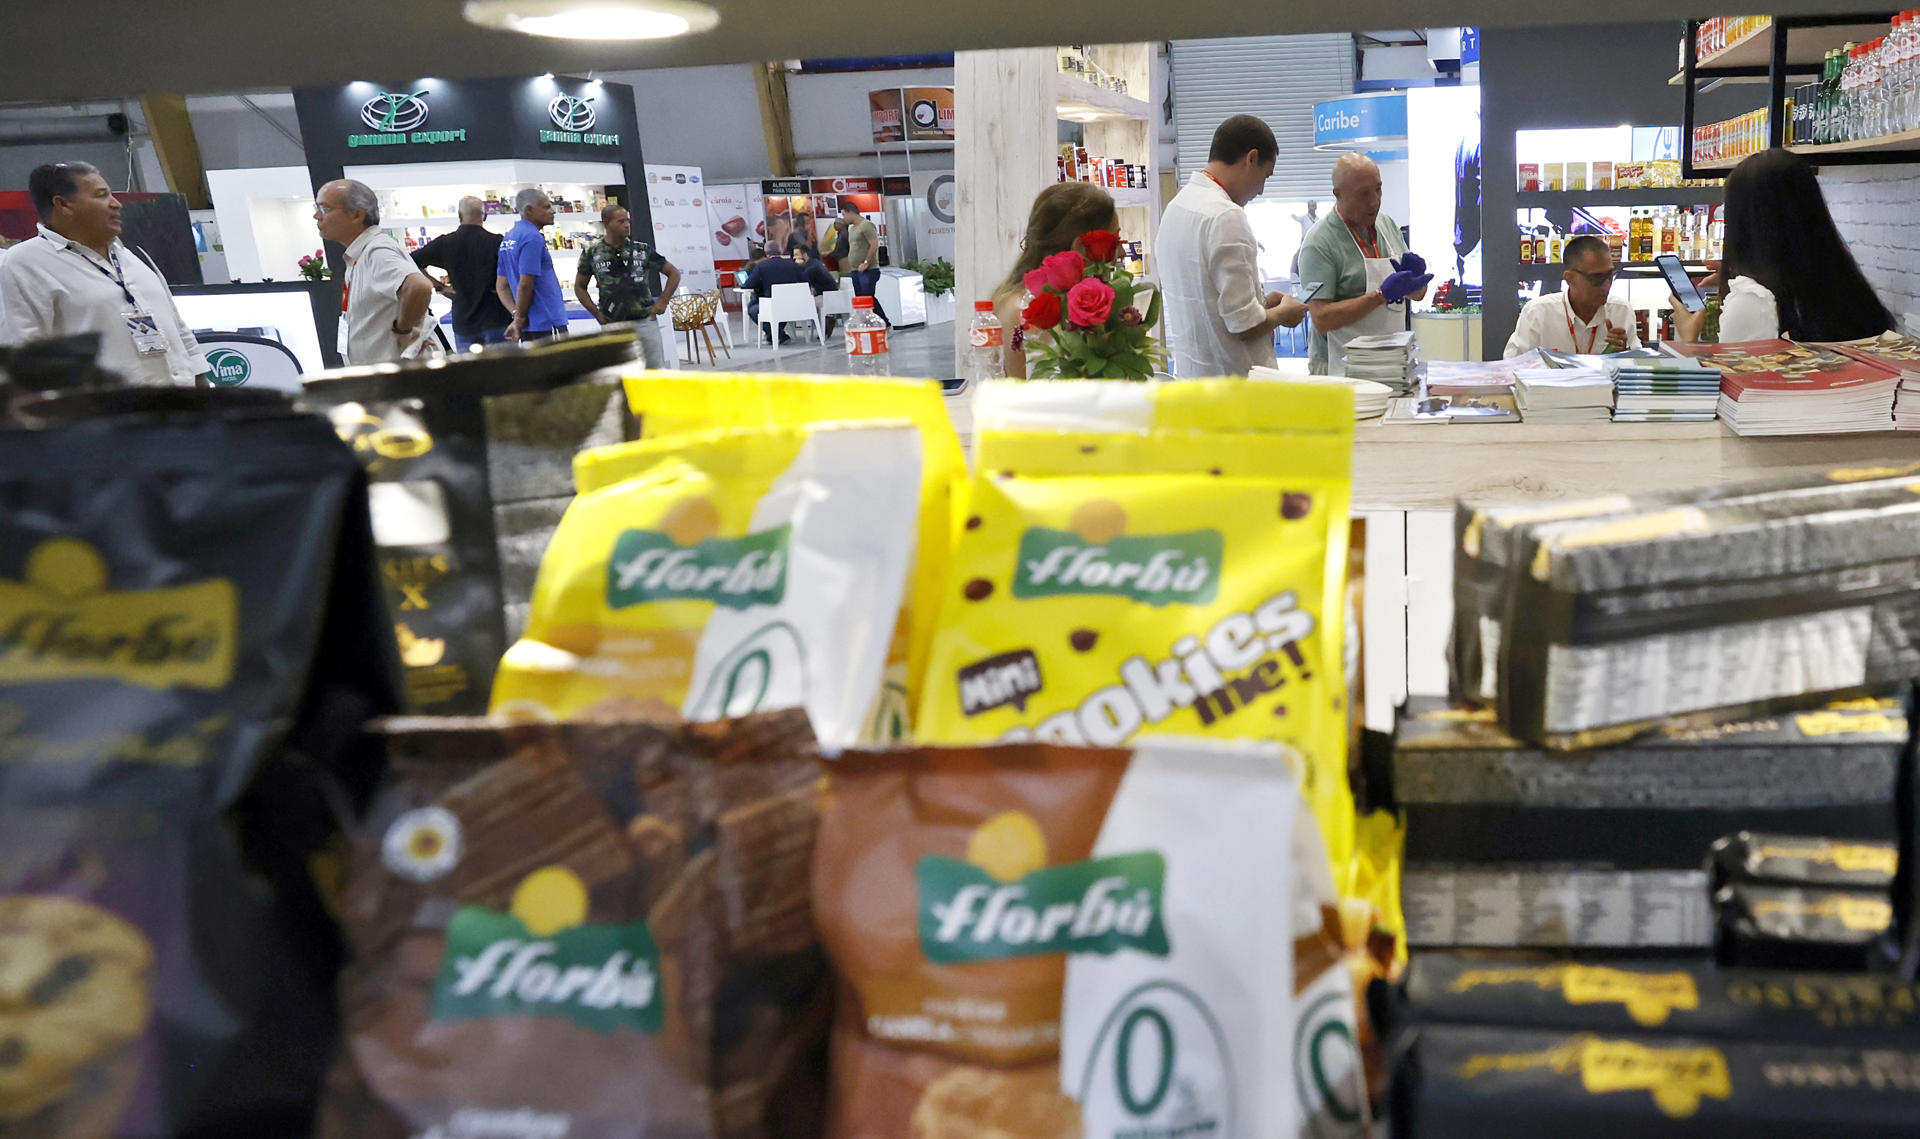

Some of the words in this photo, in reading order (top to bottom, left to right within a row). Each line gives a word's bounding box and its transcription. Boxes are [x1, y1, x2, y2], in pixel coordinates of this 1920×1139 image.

[1318, 110, 1361, 132] Caribe
[348, 132, 406, 148] gamma
[410, 128, 467, 144] export
[539, 129, 582, 144] gamma
[583, 132, 620, 146] export
